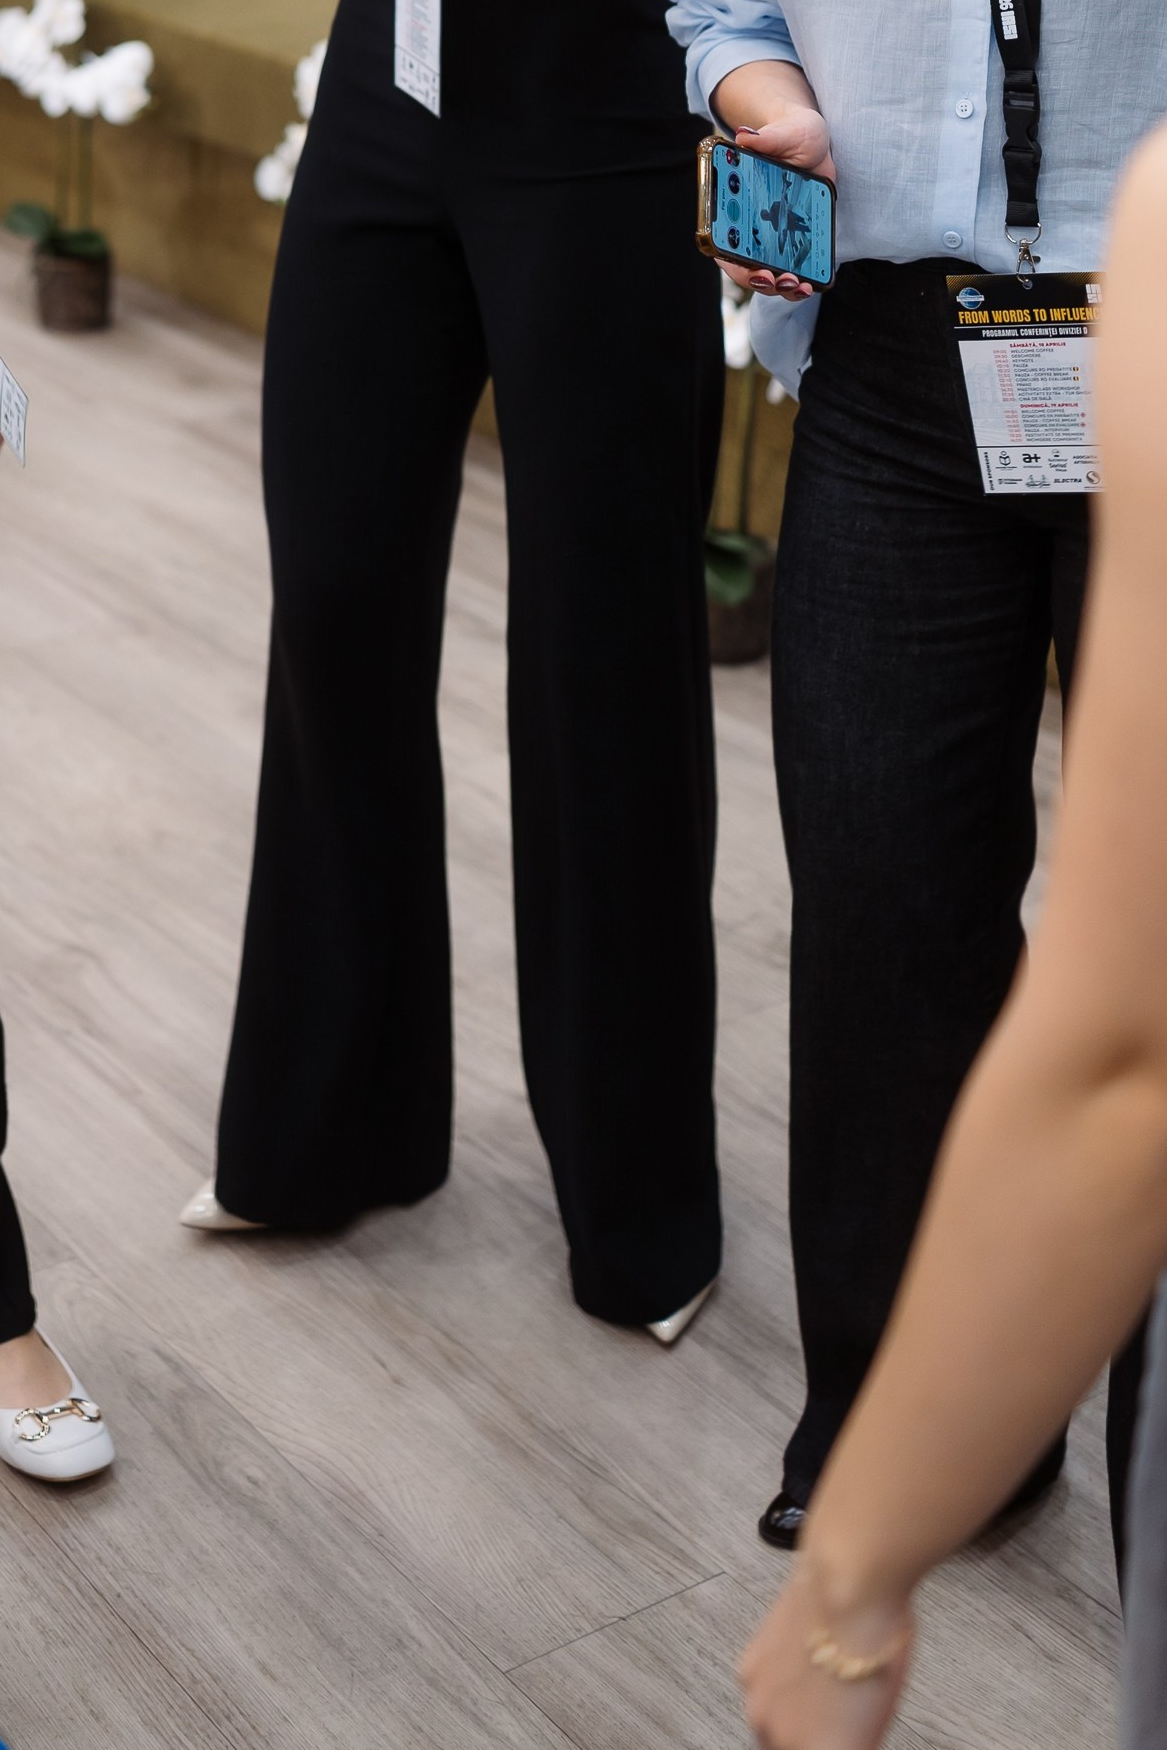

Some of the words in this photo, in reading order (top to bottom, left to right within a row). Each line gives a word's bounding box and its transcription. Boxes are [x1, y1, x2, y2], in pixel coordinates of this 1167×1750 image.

[958, 310, 990, 324] FROM
[992, 309, 1031, 323] WORDS
[1033, 309, 1047, 322] TO
[1050, 307, 1102, 321] INFLUENC
[982, 329, 1019, 338] PROGRAMUL
[1059, 326, 1083, 336] DIVIZIEI
